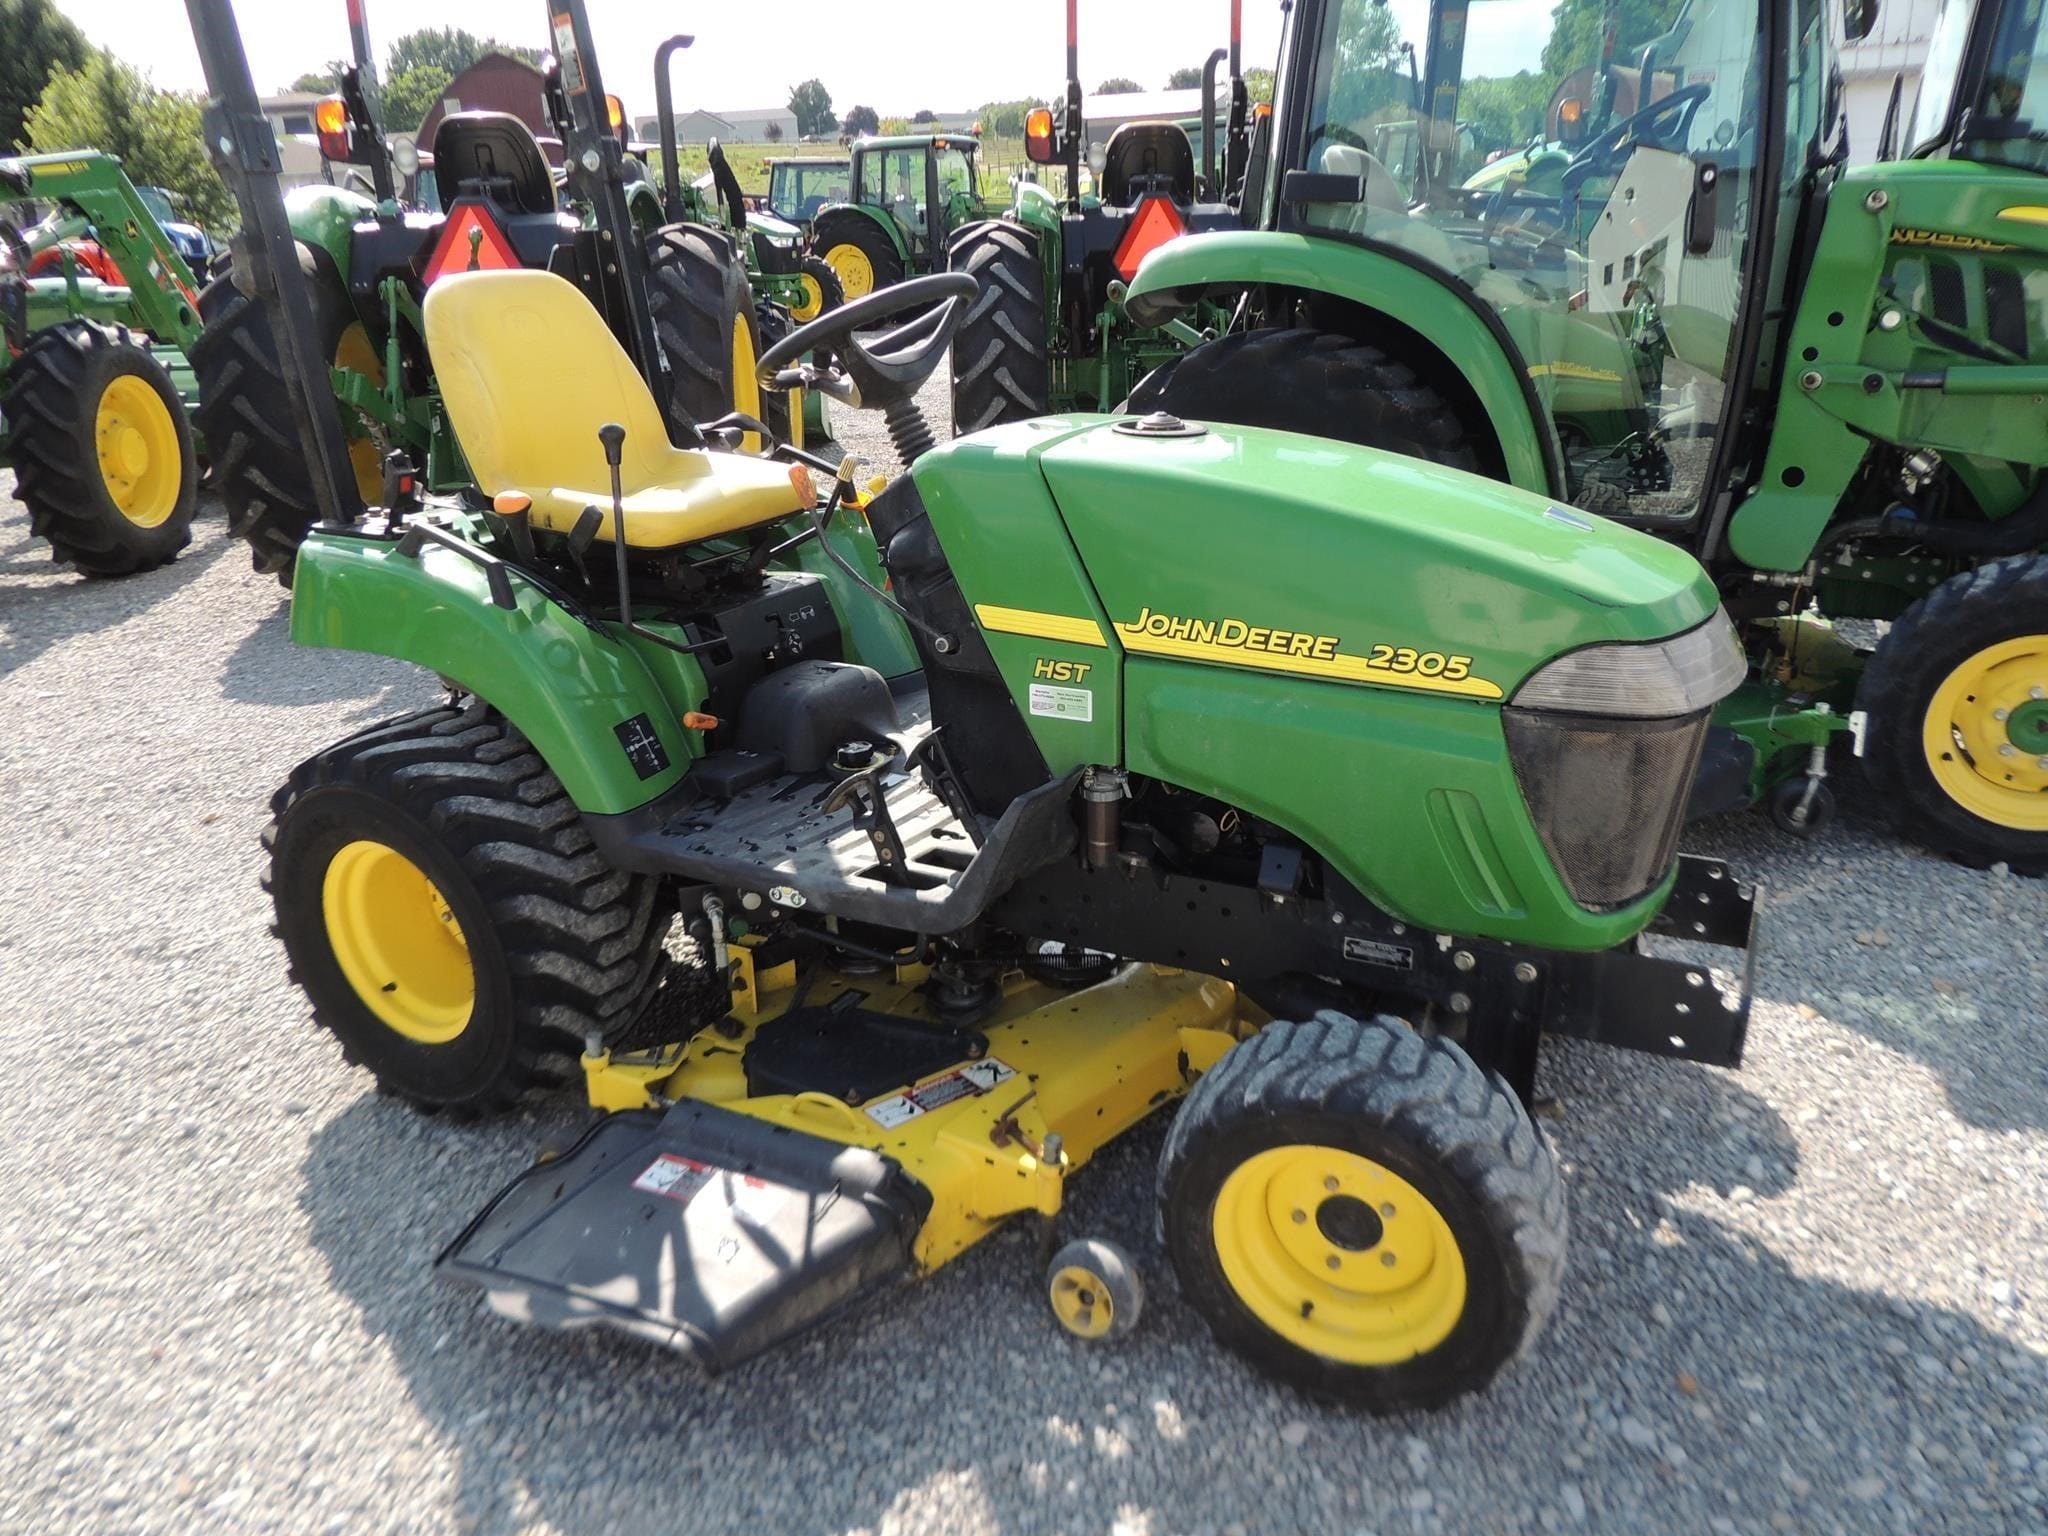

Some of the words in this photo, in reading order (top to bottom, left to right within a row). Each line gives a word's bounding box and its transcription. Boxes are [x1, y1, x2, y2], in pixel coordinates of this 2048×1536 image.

[1124, 607, 1216, 644] JOHN
[1216, 617, 1339, 660] DEERE
[1366, 643, 1473, 681] 2305
[1033, 657, 1093, 684] HST
